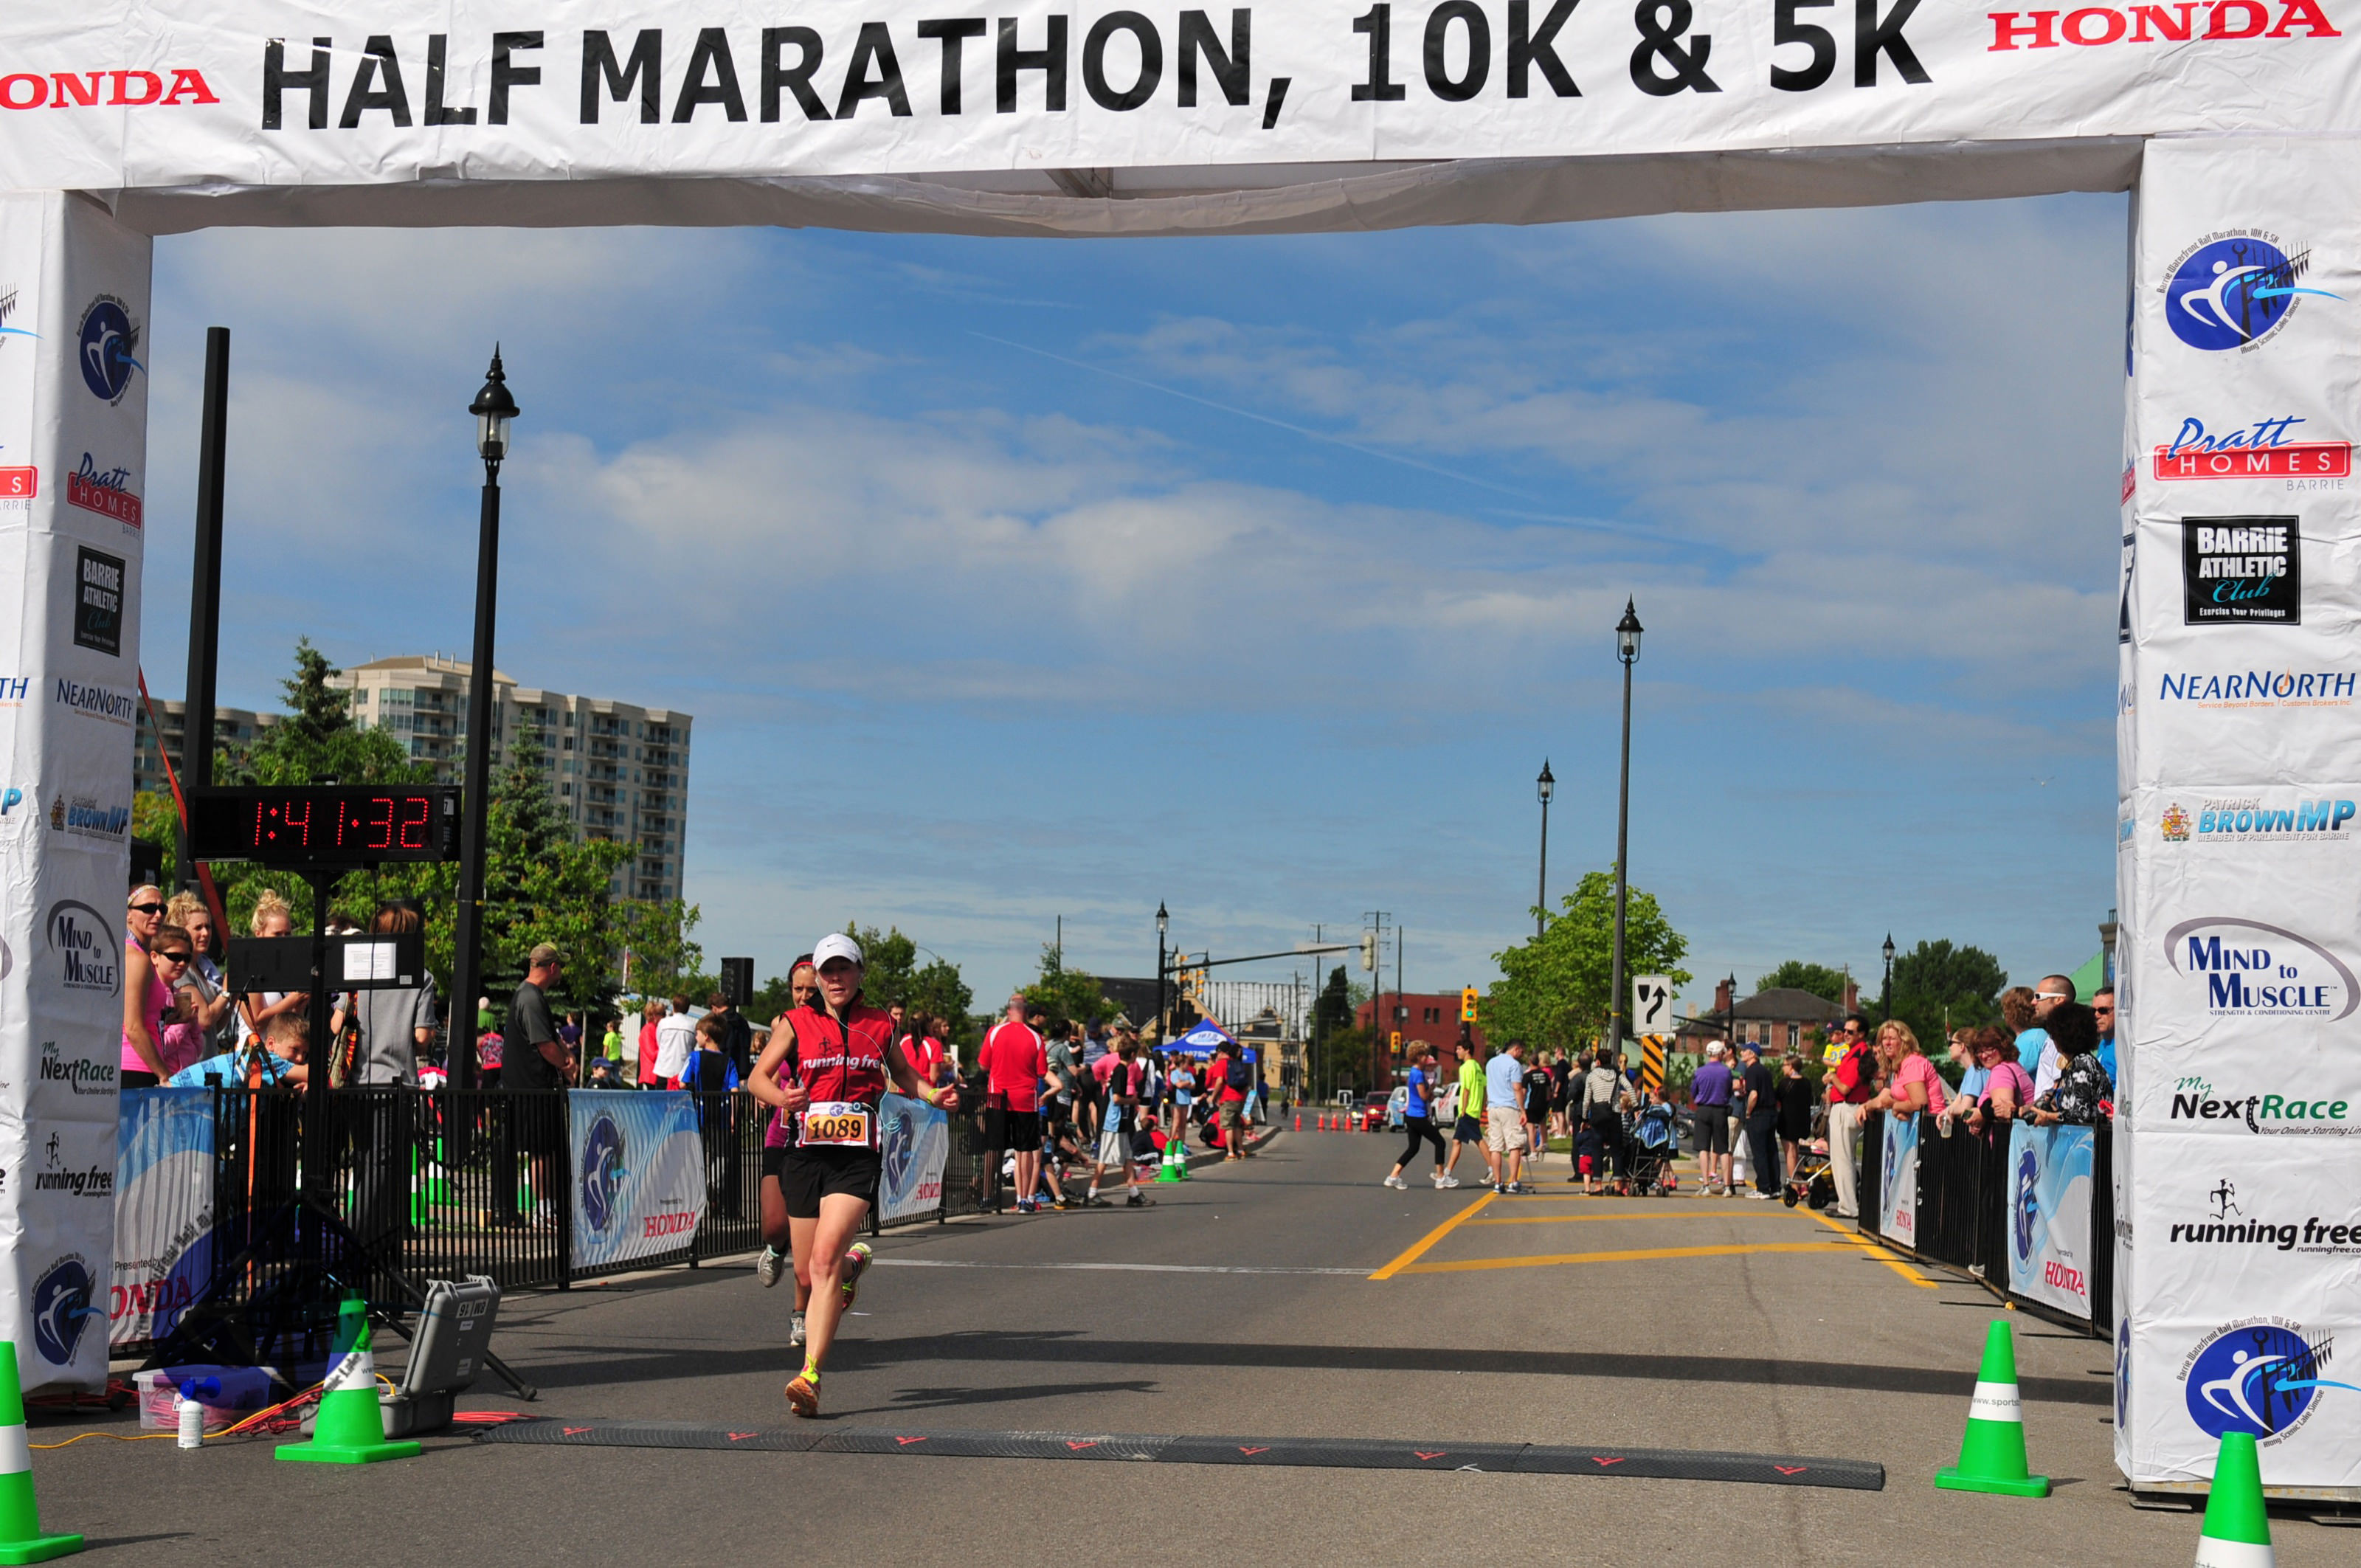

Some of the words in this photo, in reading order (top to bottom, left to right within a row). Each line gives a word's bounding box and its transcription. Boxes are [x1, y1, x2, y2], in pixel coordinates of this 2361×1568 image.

[1987, 0, 2343, 52] HONDA
[262, 30, 545, 131] HALF
[579, 7, 1292, 130] MARATHON,
[1350, 0, 1583, 103] 10K
[1629, 0, 1724, 97] &
[1770, 0, 1934, 92] 5K
[2167, 415, 2307, 460] Pratt
[75, 452, 131, 492] Pratt
[2180, 452, 2331, 474] HOMES
[2286, 479, 2345, 491] BARRIE
[0, 500, 31, 511] RRIE
[80, 486, 137, 520] HOMES
[2196, 526, 2289, 554] BARRIE
[83, 558, 120, 592] BARRIE
[2199, 556, 2287, 578] ATHLETIC
[2213, 569, 2278, 603] Club
[83, 586, 118, 613] ATHLETIC
[87, 608, 111, 631] Club
[2199, 607, 2230, 618] Exercise
[2232, 607, 2247, 618] Your
[2250, 607, 2286, 618] Privileges
[2160, 670, 2357, 700] NEARNORTH
[2197, 701, 2222, 709] Service
[2224, 700, 2247, 710] Beyond
[2282, 700, 2312, 708] Customs
[2312, 700, 2337, 708] Brokers
[2201, 797, 2261, 811] PATRICK
[68, 804, 109, 832] BROWN
[2198, 809, 2295, 834] BROWN
[2197, 833, 2235, 843] MEMBER
[2236, 833, 2248, 842] OF
[2248, 832, 2301, 842] PARLIAMENT
[2300, 832, 2318, 841] FOR
[2319, 832, 2350, 841] BARRIE
[58, 916, 92, 950] MIND
[94, 944, 102, 959] to
[64, 950, 114, 986] MUSCLE
[2188, 936, 2272, 971] MIND
[2278, 963, 2298, 979] to
[42, 1041, 60, 1063] My
[803, 1054, 860, 1070] running
[2174, 1077, 2213, 1102] My
[811, 1119, 862, 1139] 1089
[2259, 1126, 2280, 1135] Your
[2281, 1125, 2311, 1135] Online
[2311, 1125, 2348, 1136] Starting
[35, 1167, 87, 1196] running
[2170, 1219, 2299, 1251] running
[2303, 1217, 2361, 1244] free
[2297, 1245, 2361, 1255] runningfree.co
[114, 1257, 153, 1271] Presented
